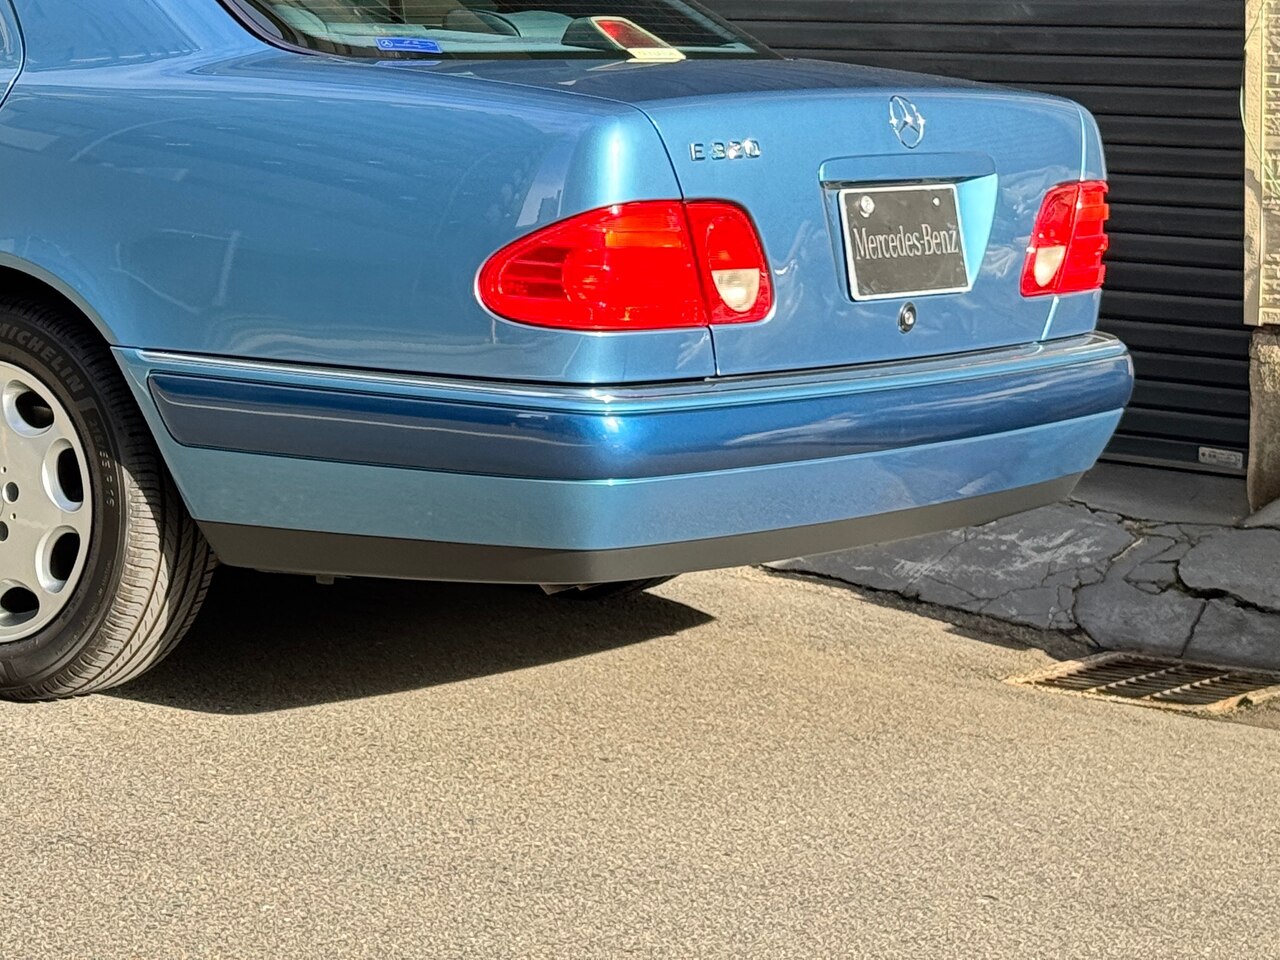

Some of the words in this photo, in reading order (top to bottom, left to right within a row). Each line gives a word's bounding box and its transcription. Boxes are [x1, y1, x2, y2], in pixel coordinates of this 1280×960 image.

[689, 143, 706, 161] E
[711, 139, 761, 161] 320
[852, 223, 959, 260] Mercedes-Benz
